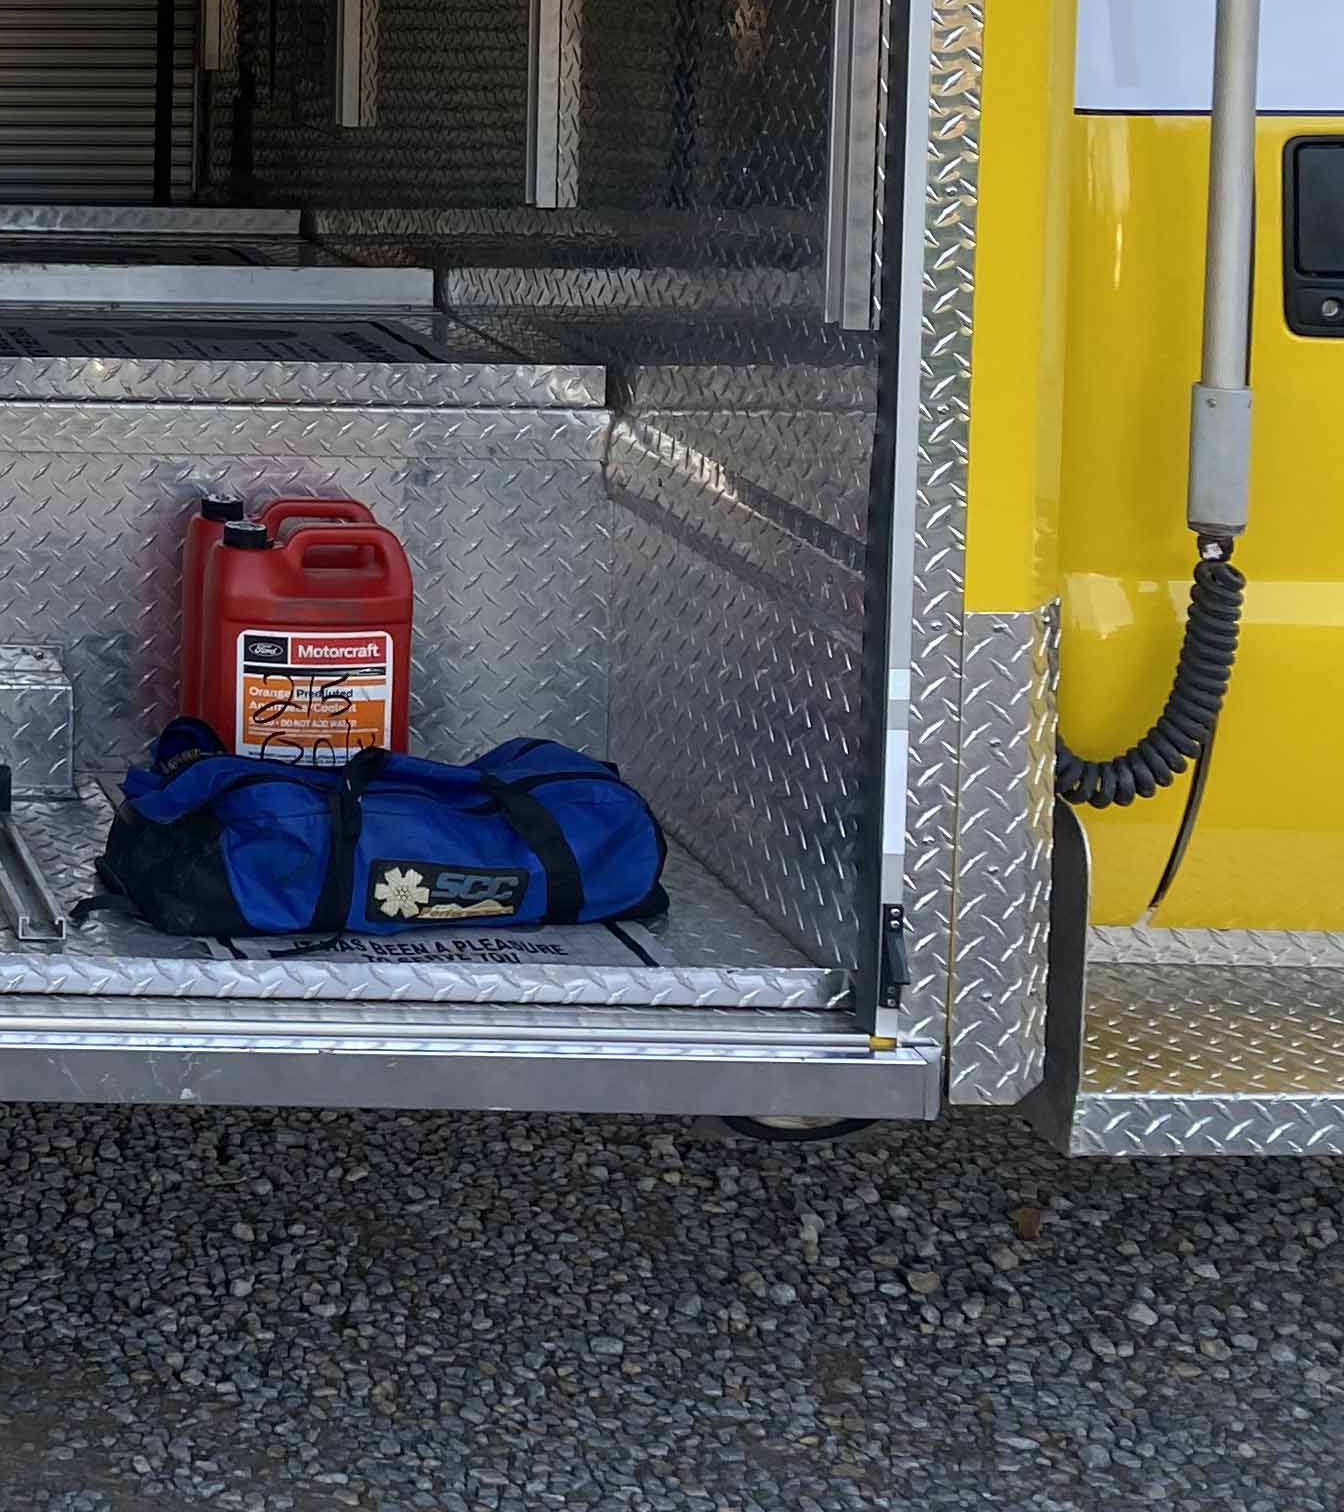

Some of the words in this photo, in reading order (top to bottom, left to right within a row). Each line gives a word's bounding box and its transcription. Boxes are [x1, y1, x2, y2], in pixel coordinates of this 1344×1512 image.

[254, 644, 279, 656] Ford
[297, 642, 381, 659] Motorcraft
[369, 942, 428, 956] BEEN
[435, 941, 450, 954] A
[452, 938, 569, 956] PLEASURE
[478, 953, 521, 963] YOU
